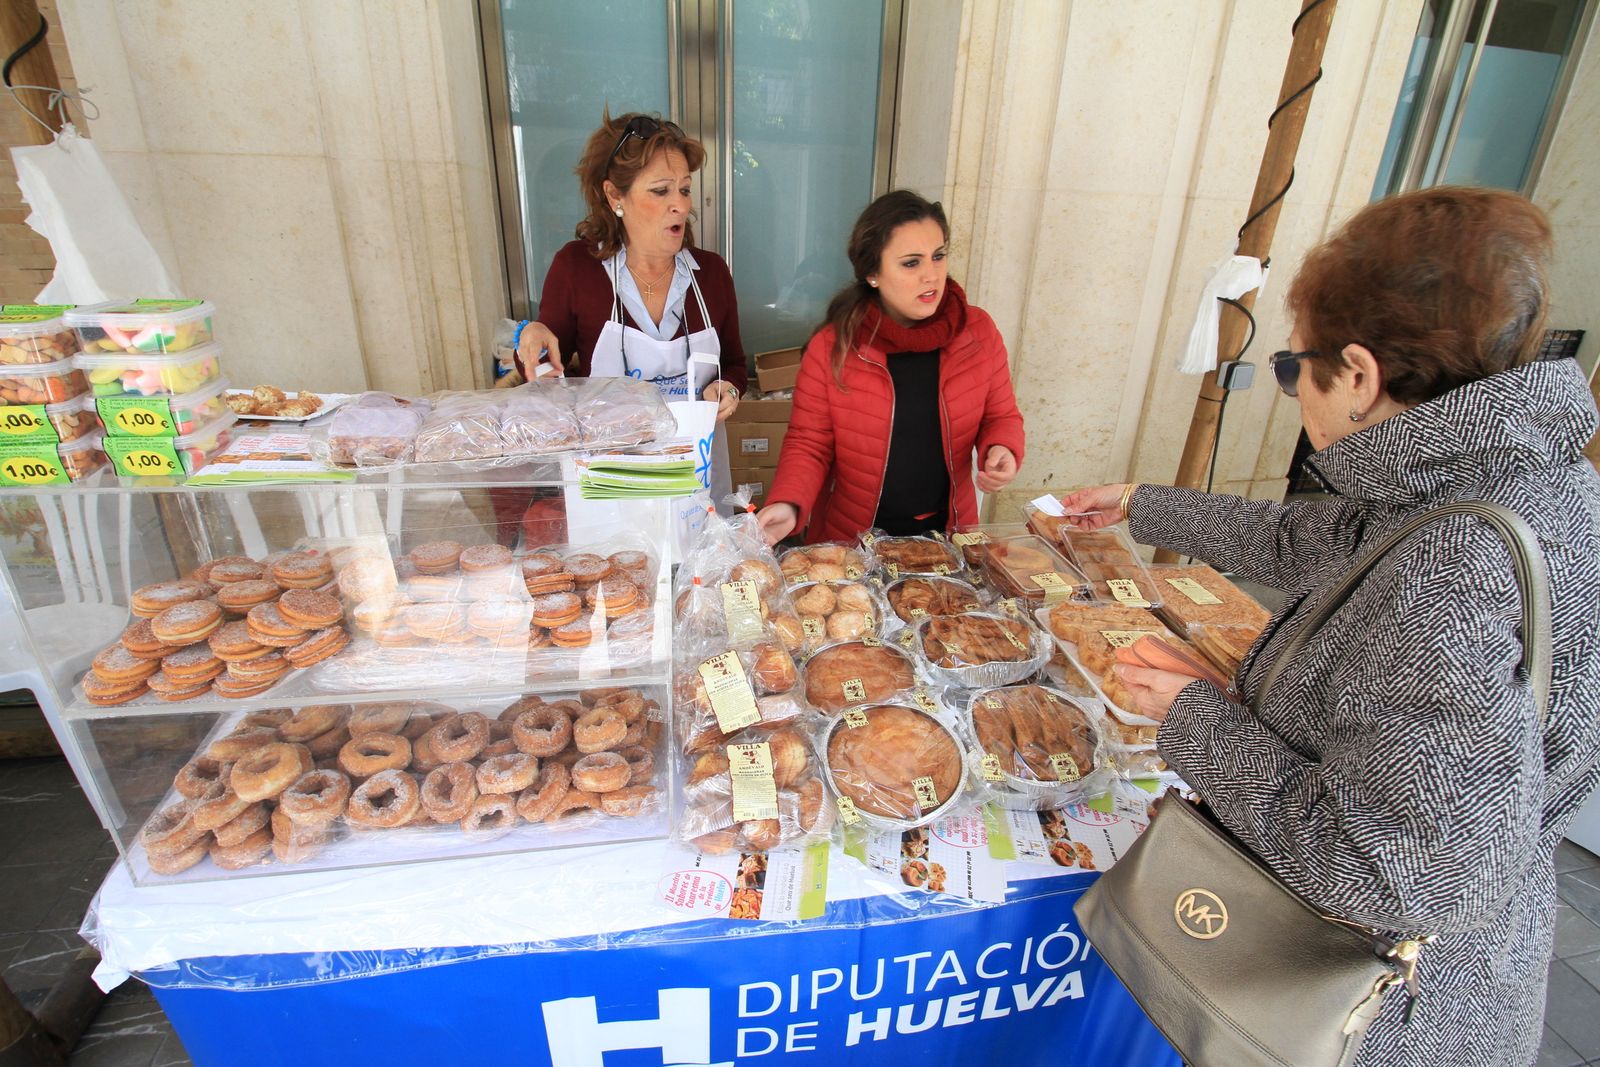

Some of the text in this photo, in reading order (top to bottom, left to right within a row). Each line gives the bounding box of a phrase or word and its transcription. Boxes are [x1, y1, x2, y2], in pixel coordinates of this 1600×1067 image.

[119, 413, 170, 429] 1,00 €
[126, 455, 176, 469] 1,00 €
[706, 654, 729, 665] VILLA
[675, 881, 689, 907] Sabores
[685, 876, 700, 908] Cuaresma
[736, 970, 1085, 1058] DE HUELVA
